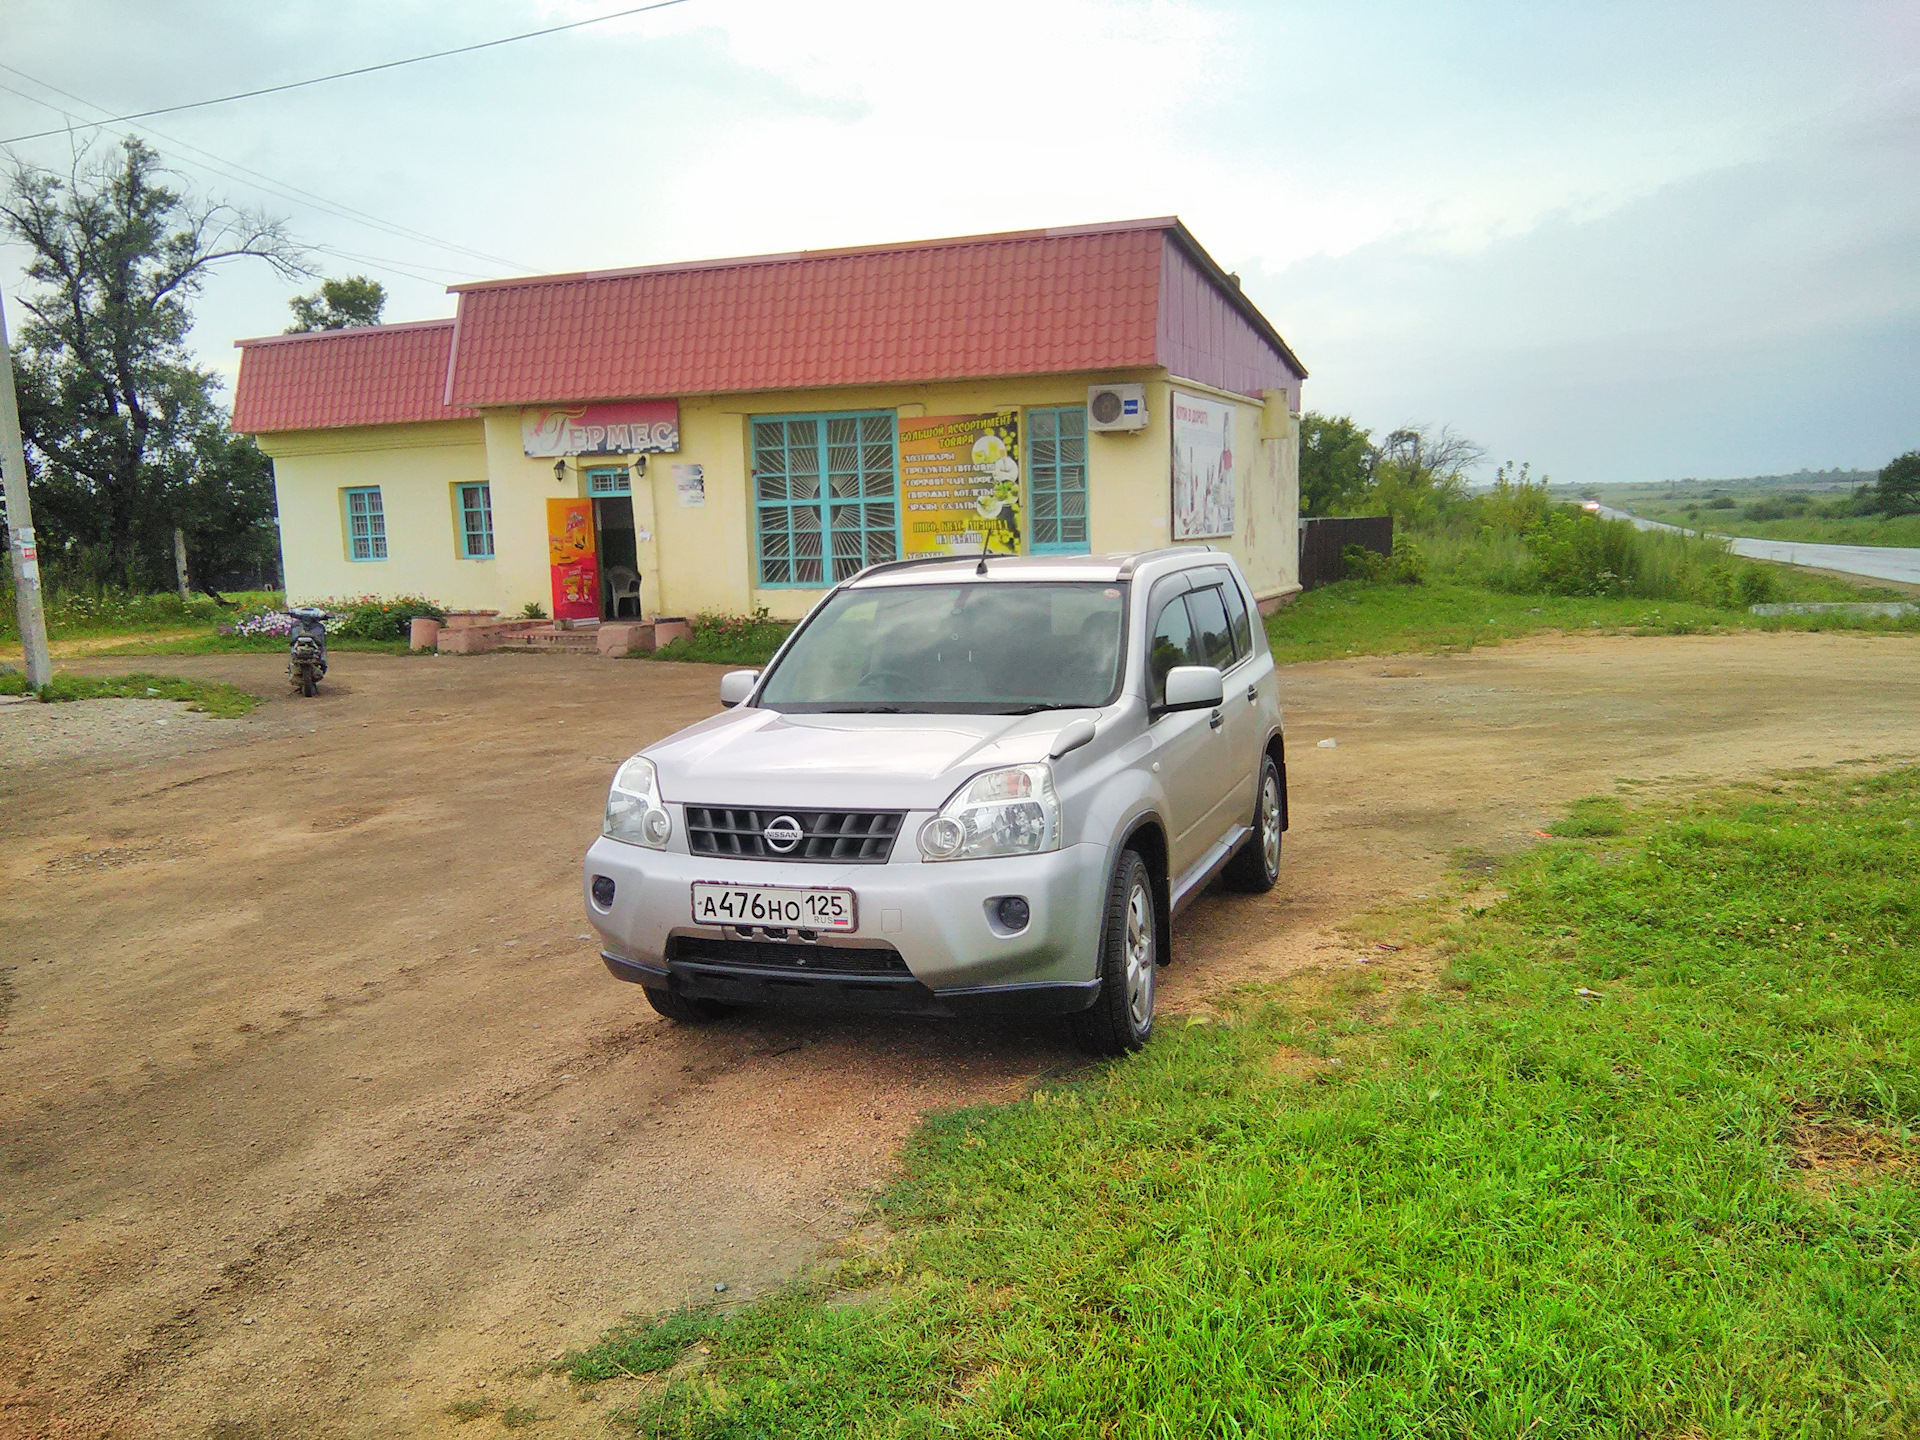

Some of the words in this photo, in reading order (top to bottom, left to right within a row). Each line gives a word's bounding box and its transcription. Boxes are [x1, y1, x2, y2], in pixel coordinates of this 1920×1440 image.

[900, 424, 945, 442] БОЛЬШОЙ
[947, 414, 1012, 435] АССОРТИМЕНТ
[939, 434, 975, 448] ТОВАРА
[905, 453, 955, 463] ХОЗТОВАРЫ
[905, 465, 952, 475] ПРОДУКТЫ
[954, 463, 996, 473] ПИТАНИЯ
[766, 831, 798, 839] NISSAN
[703, 891, 800, 921] А476НО
[805, 895, 843, 916] 125
[814, 916, 833, 924] RUS
